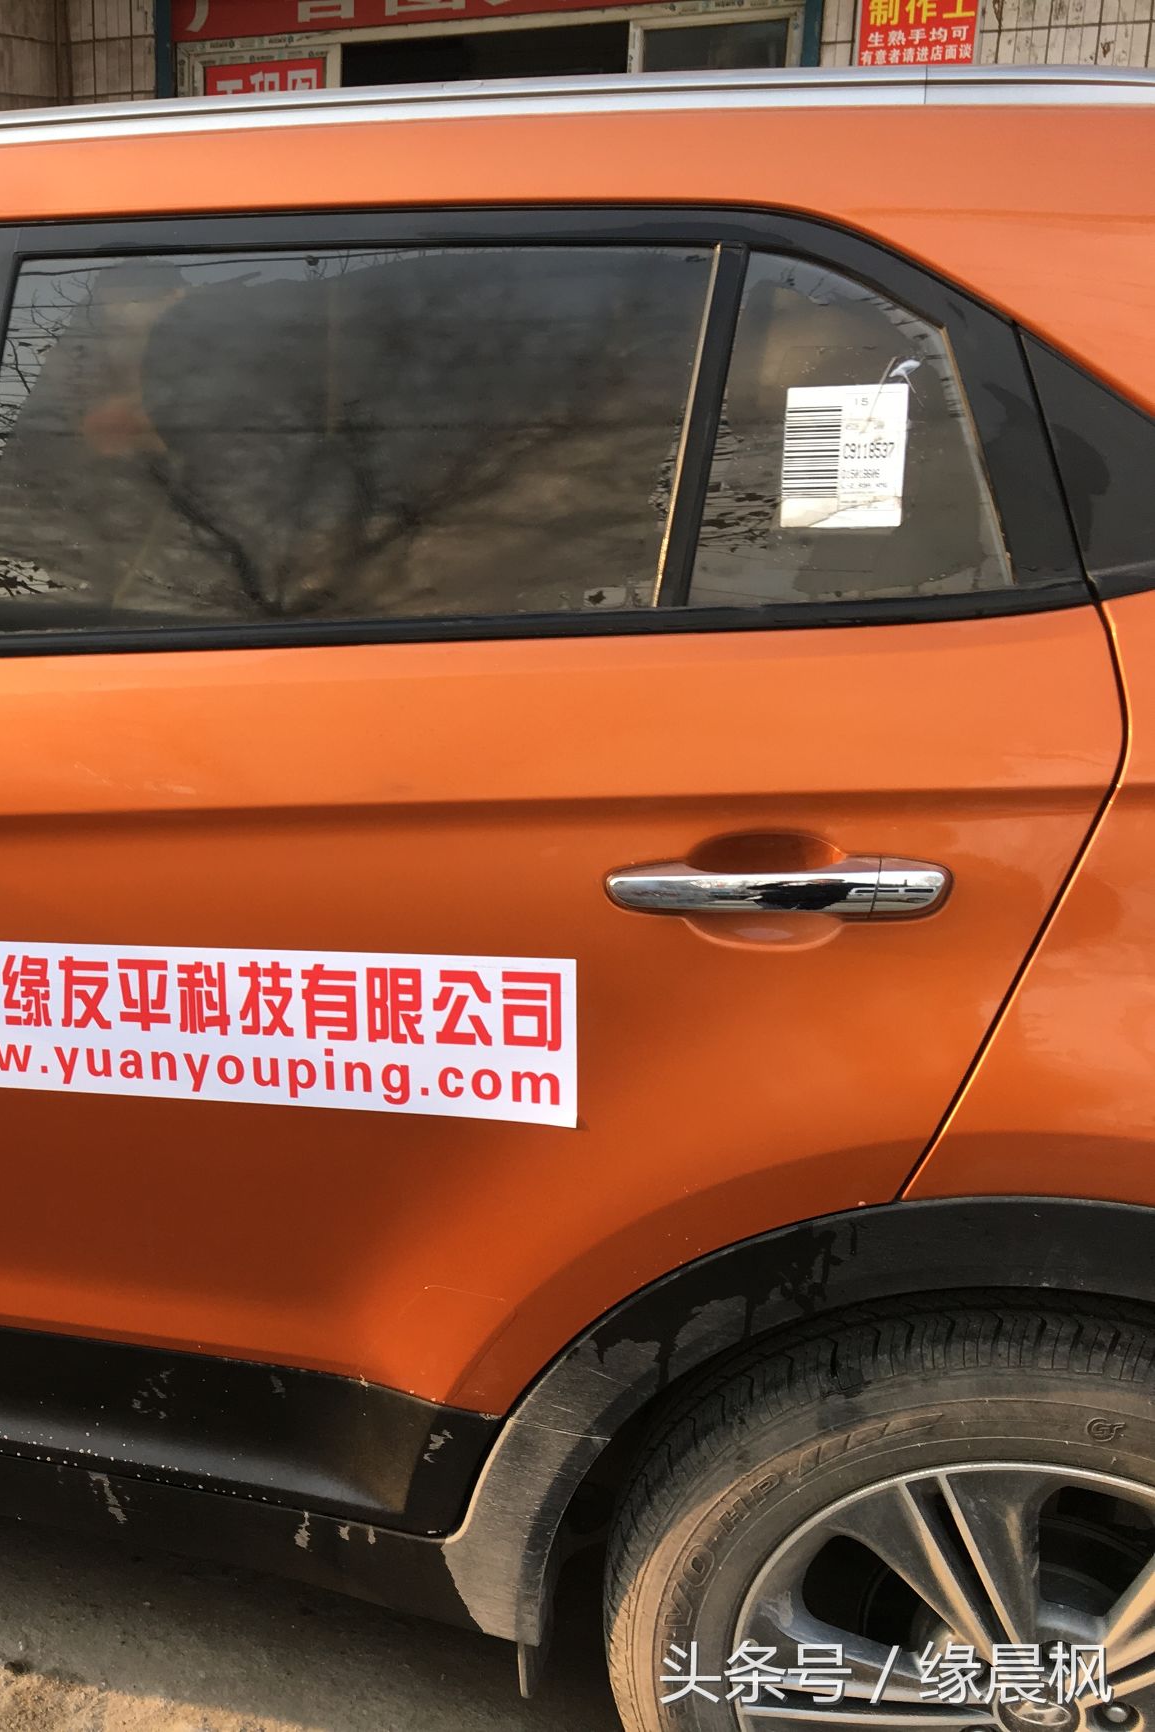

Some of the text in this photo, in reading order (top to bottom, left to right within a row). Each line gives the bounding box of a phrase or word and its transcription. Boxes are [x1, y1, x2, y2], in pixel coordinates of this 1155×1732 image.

[868, 0, 975, 26] 制作工
[867, 25, 969, 48] 生熟手均可
[861, 43, 972, 65] 有意者请进店面谈
